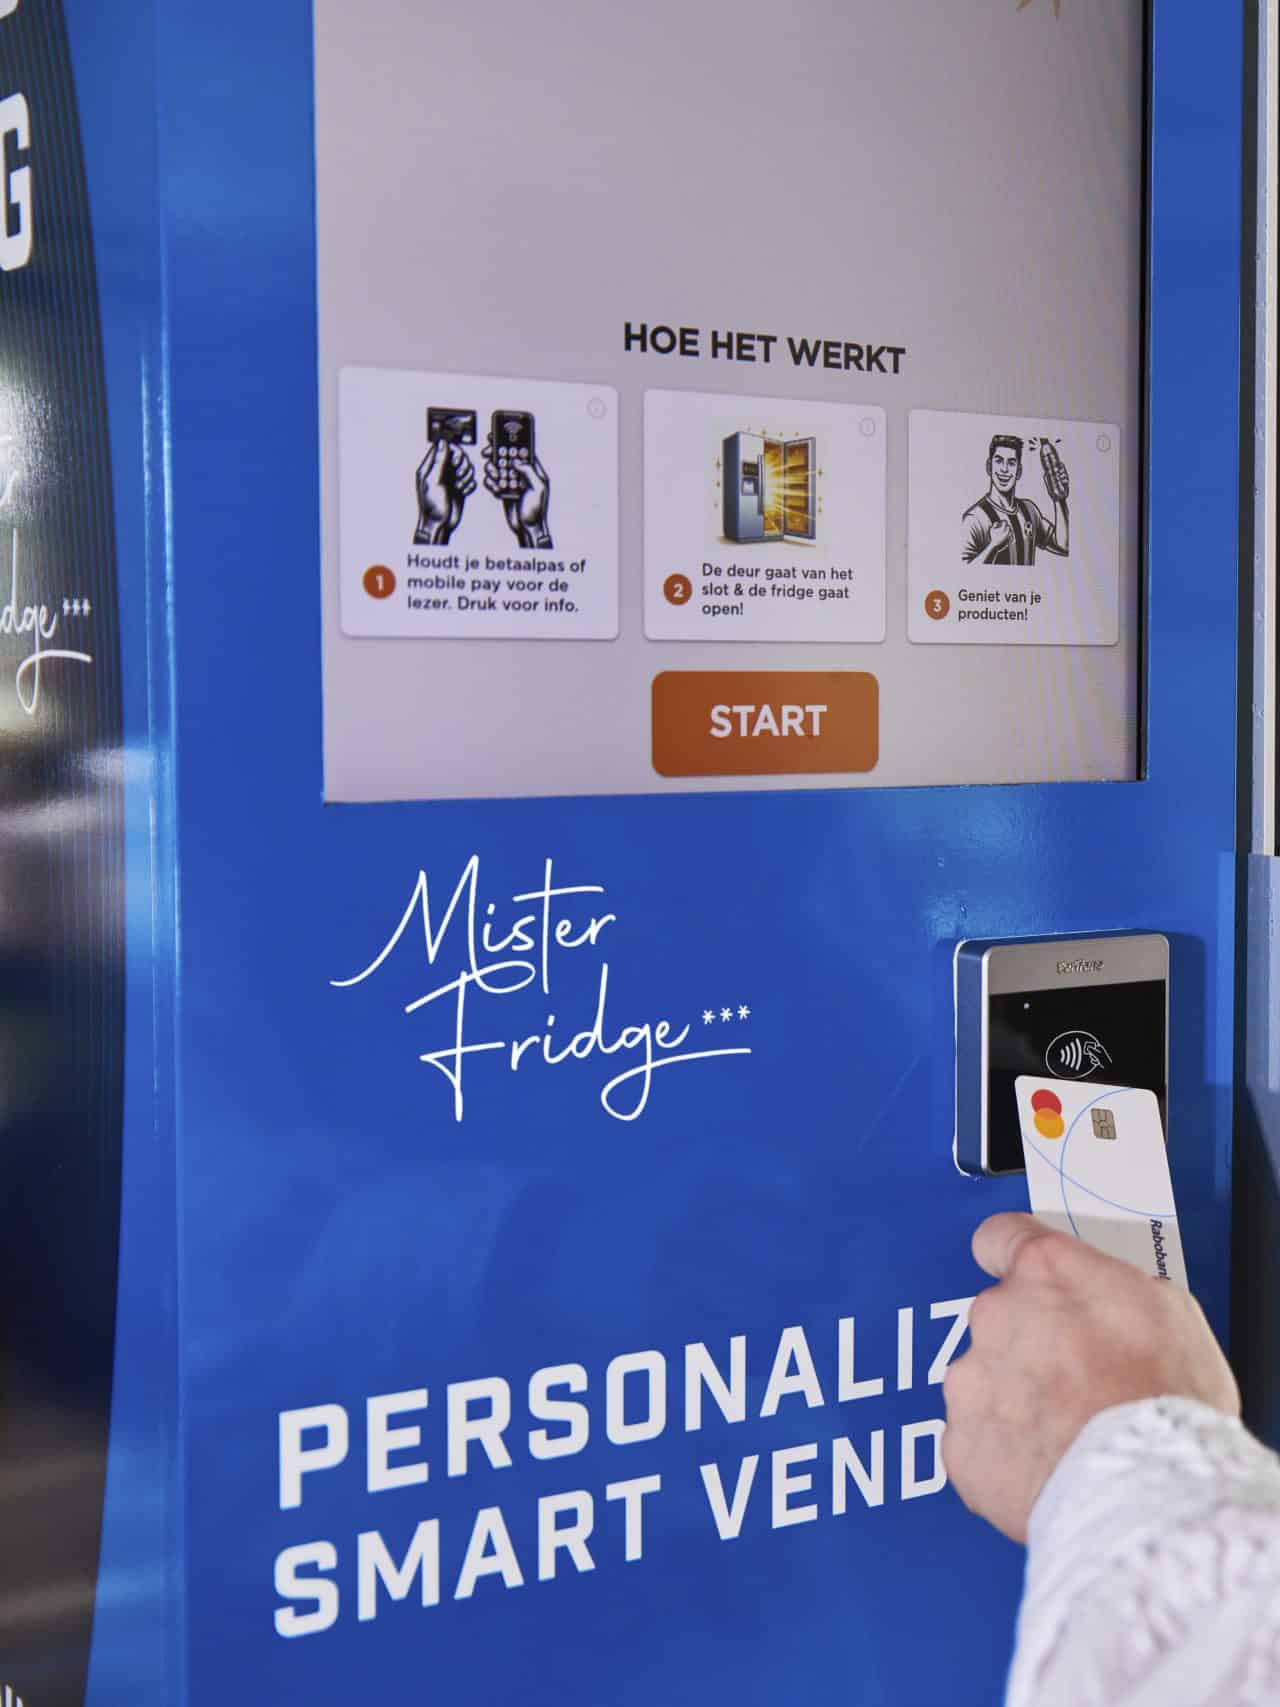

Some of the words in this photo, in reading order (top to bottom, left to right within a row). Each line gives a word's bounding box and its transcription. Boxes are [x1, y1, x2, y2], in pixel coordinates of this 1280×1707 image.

[623, 321, 699, 357] HOE
[711, 330, 777, 363] HET
[787, 336, 906, 375] WERKT
[407, 554, 459, 569] Houdt
[465, 556, 480, 572] je
[485, 555, 565, 573] betaalpas
[569, 559, 587, 573] of
[702, 563, 722, 577] De
[727, 564, 761, 578] deur
[765, 566, 798, 581] gaat
[801, 568, 826, 580] van
[831, 567, 853, 580] het
[407, 575, 465, 590] mobile
[470, 578, 501, 593] pay
[507, 579, 544, 592] voor
[548, 577, 568, 593] de
[701, 583, 728, 597] slot
[733, 584, 744, 597] &
[748, 583, 767, 597] de
[771, 584, 814, 600] fridge
[818, 586, 850, 601] gaat
[407, 595, 451, 610] lezer.
[457, 596, 496, 611] Druk
[503, 599, 539, 612] voor
[544, 598, 579, 613] info.
[958, 588, 1001, 602] Geniet
[1004, 591, 1027, 603] van
[1029, 591, 1042, 606] je
[702, 603, 744, 617] open!
[958, 607, 1028, 622] producten!
[709, 704, 828, 738] START
[330, 855, 616, 994] Mister
[274, 1473, 661, 1639] SMART
[700, 1419, 947, 1541] VEND
